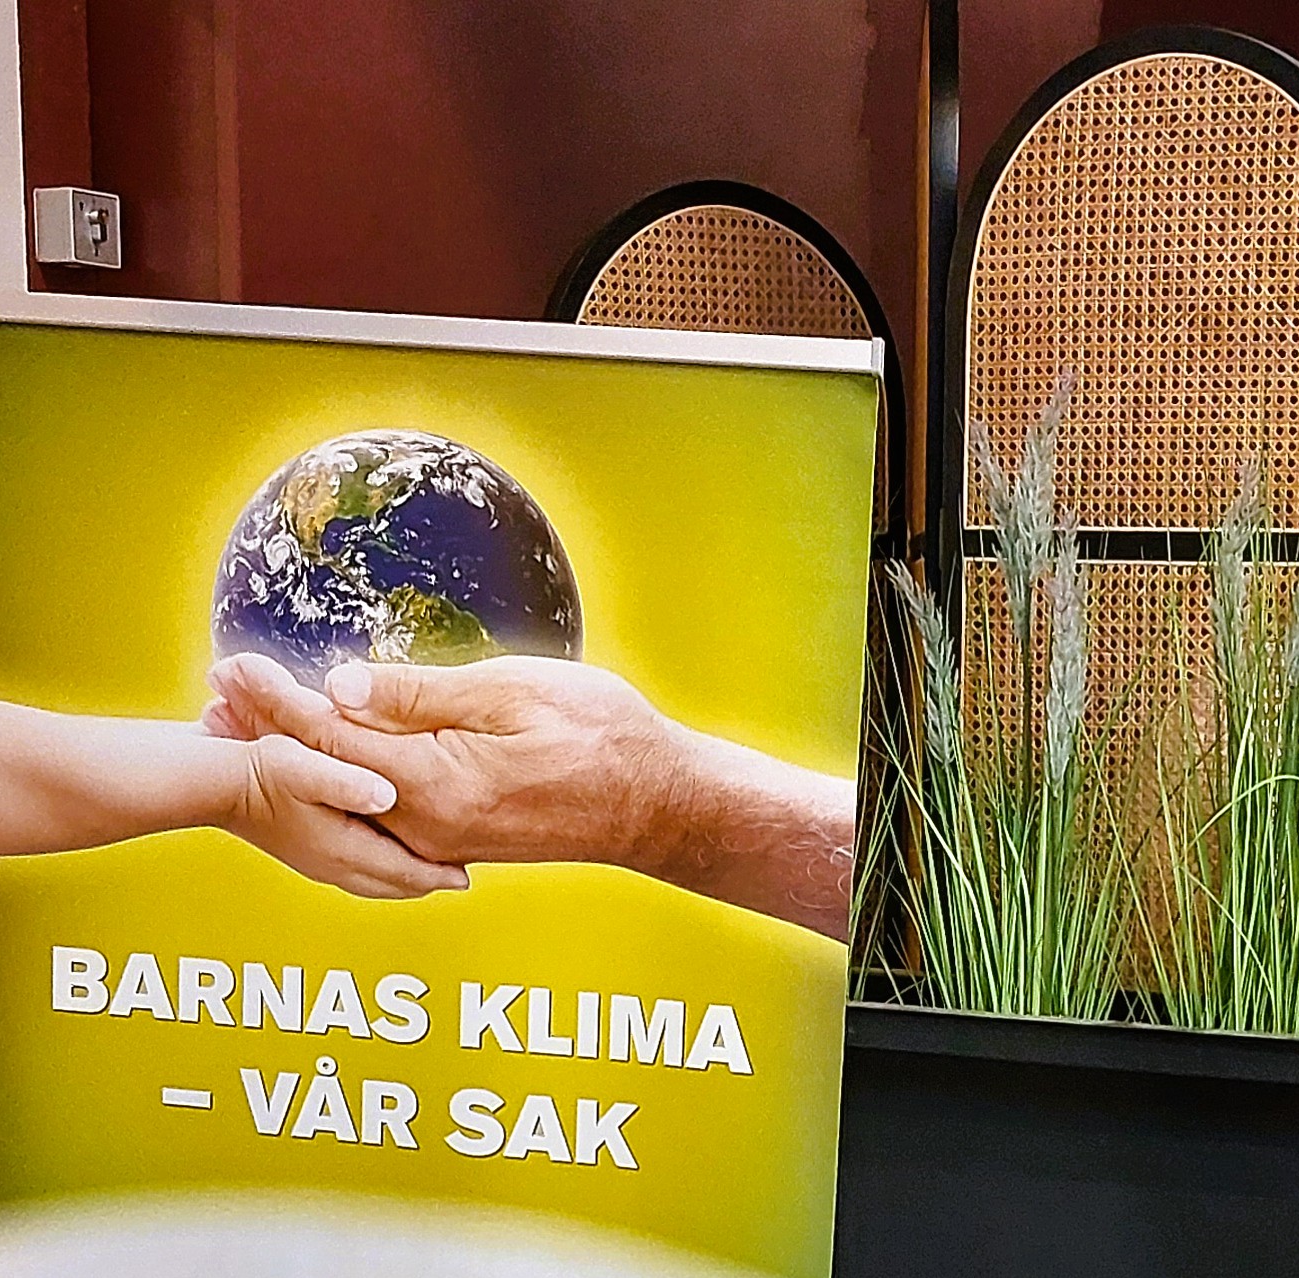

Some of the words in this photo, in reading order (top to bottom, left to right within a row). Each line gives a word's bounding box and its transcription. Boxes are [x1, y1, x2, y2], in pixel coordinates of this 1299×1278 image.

[51, 945, 431, 1045] BARNAS
[458, 981, 753, 1075] KLIMA
[239, 1055, 419, 1150] VÅR
[443, 1087, 639, 1169] SAK
